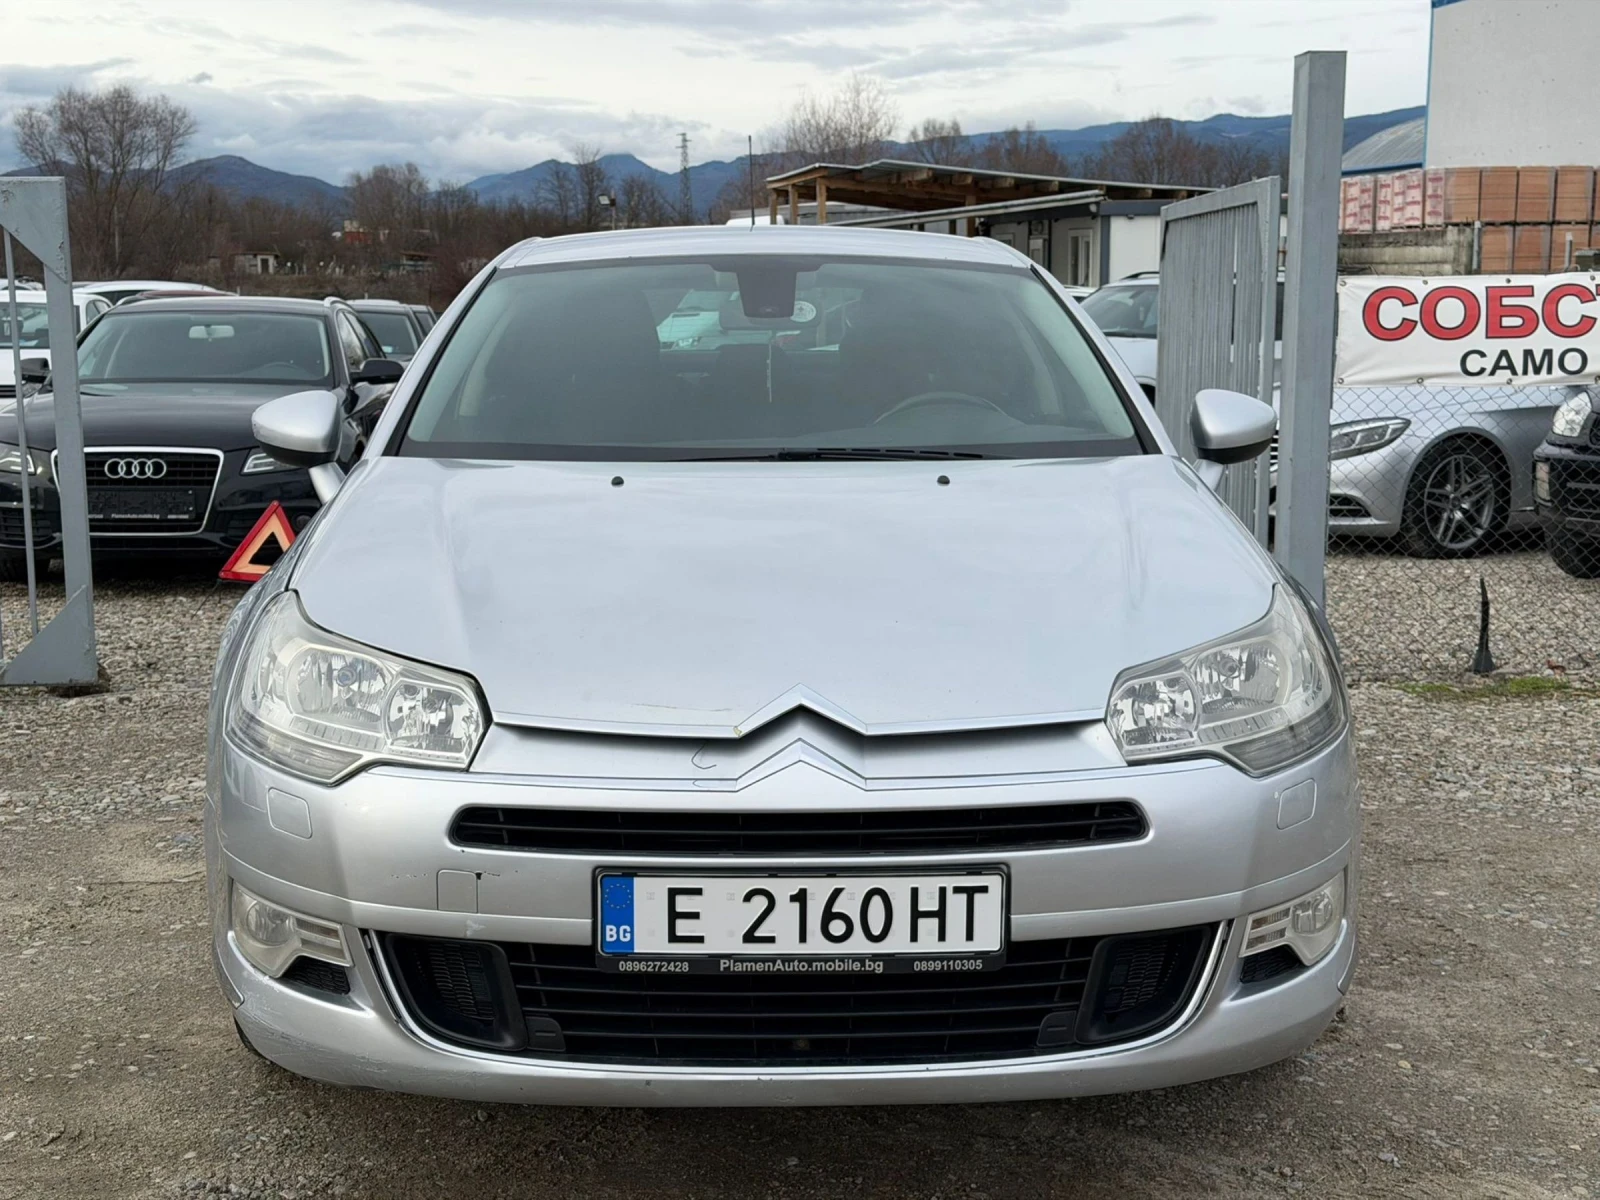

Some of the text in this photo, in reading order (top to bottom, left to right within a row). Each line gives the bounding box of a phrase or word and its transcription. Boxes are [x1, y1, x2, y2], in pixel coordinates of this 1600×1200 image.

[1362, 283, 1600, 341] СОБС
[1460, 348, 1588, 377] САМО
[667, 885, 989, 944] E 2160 HT
[605, 925, 632, 943] BG
[618, 959, 983, 973] 0896272428 PlamenAuto.mobile.bg 0899110305
